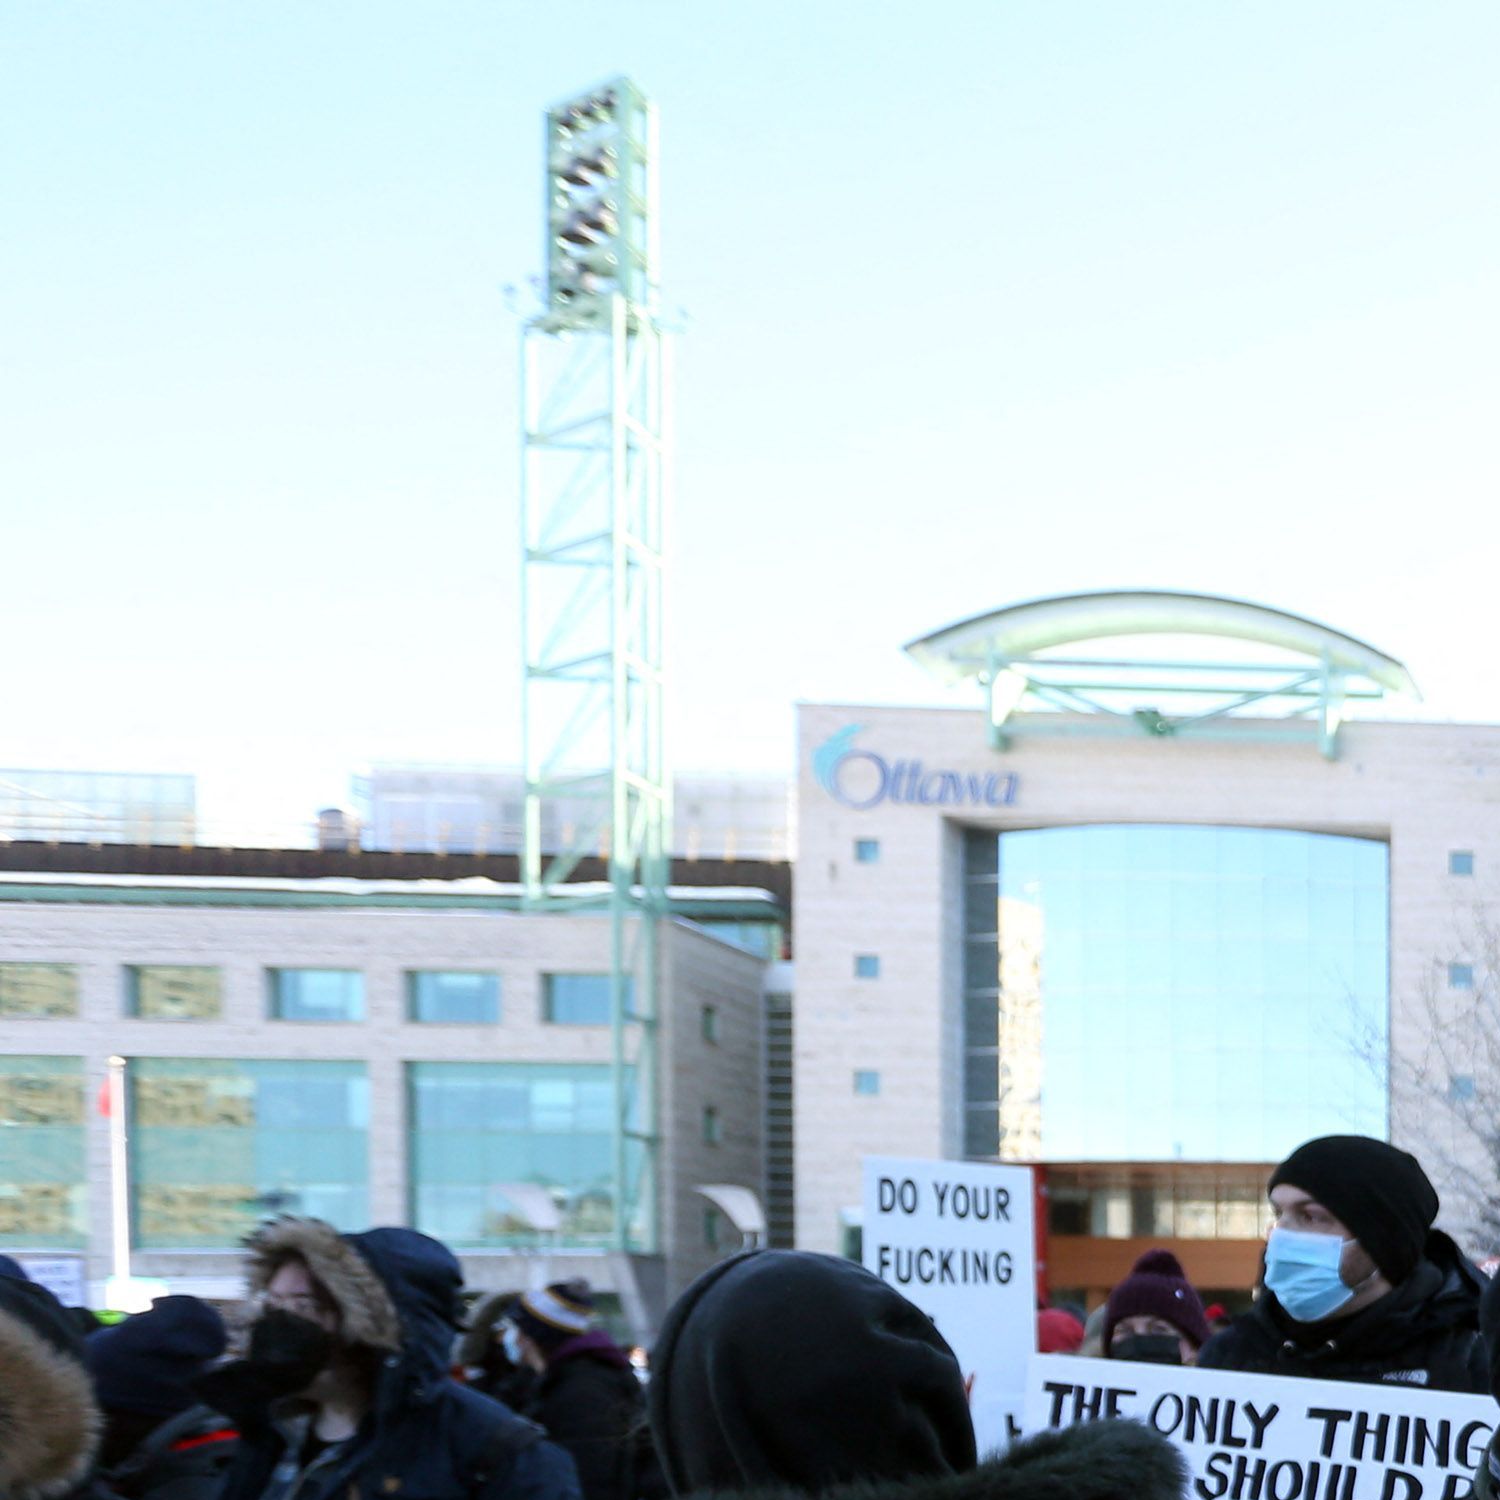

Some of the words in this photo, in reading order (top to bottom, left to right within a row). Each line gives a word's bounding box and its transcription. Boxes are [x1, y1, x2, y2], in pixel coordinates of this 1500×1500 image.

[830, 748, 1021, 811] Ottawa
[877, 1177, 918, 1215] DO
[932, 1181, 1012, 1222] YOUR
[877, 1246, 1013, 1285] FUCKING
[1147, 1391, 1280, 1450] ONLY
